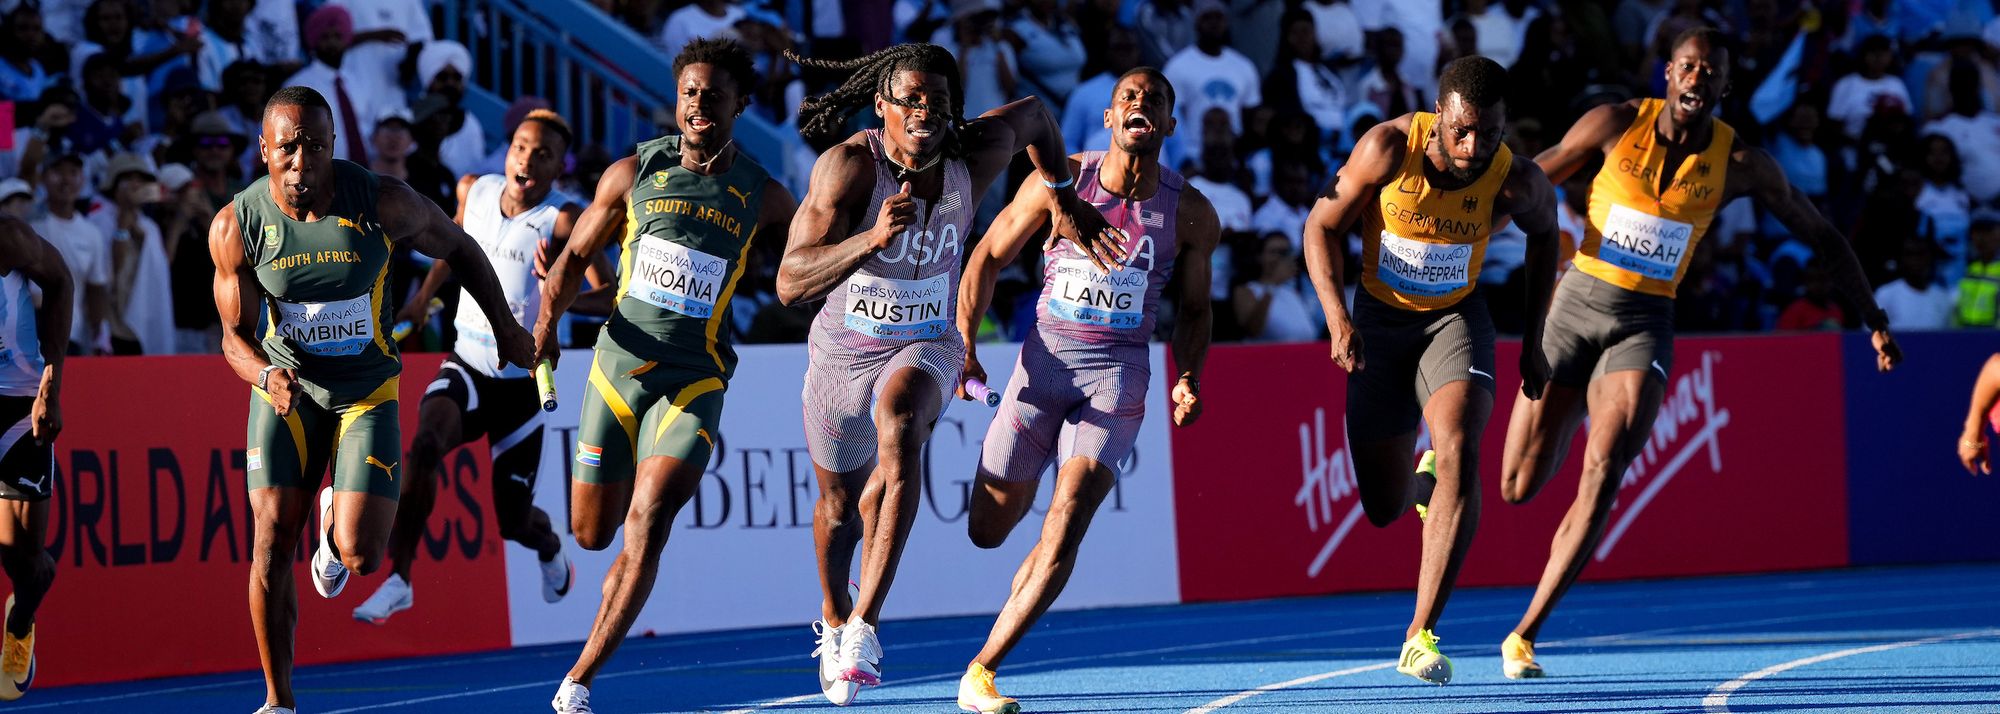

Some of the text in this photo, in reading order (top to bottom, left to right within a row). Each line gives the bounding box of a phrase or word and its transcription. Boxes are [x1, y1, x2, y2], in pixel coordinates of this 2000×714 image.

[645, 199, 742, 238] SOUTH AFRICA
[1385, 202, 1482, 237] GERMANY
[1612, 215, 1674, 240] BSWANA
[877, 223, 958, 265] USA
[1073, 228, 1155, 271] SA
[1606, 231, 1680, 263] ANSAH
[271, 250, 361, 271] SOUTH AFRICA
[640, 244, 709, 275] DEBSWANA
[1382, 252, 1465, 282] ANSAH-PEPRAH
[638, 260, 712, 302] NKOANA
[850, 283, 931, 300] DEBSWANA
[1057, 266, 1129, 287] DEBSWANA
[852, 298, 941, 323] AUSTIN
[1063, 281, 1132, 310] LANG
[281, 319, 367, 343] SIMBINE
[928, 324, 942, 334] 26
[1125, 316, 1137, 325] 26
[685, 427, 822, 530] BEE
[44, 447, 187, 568] ORLD
